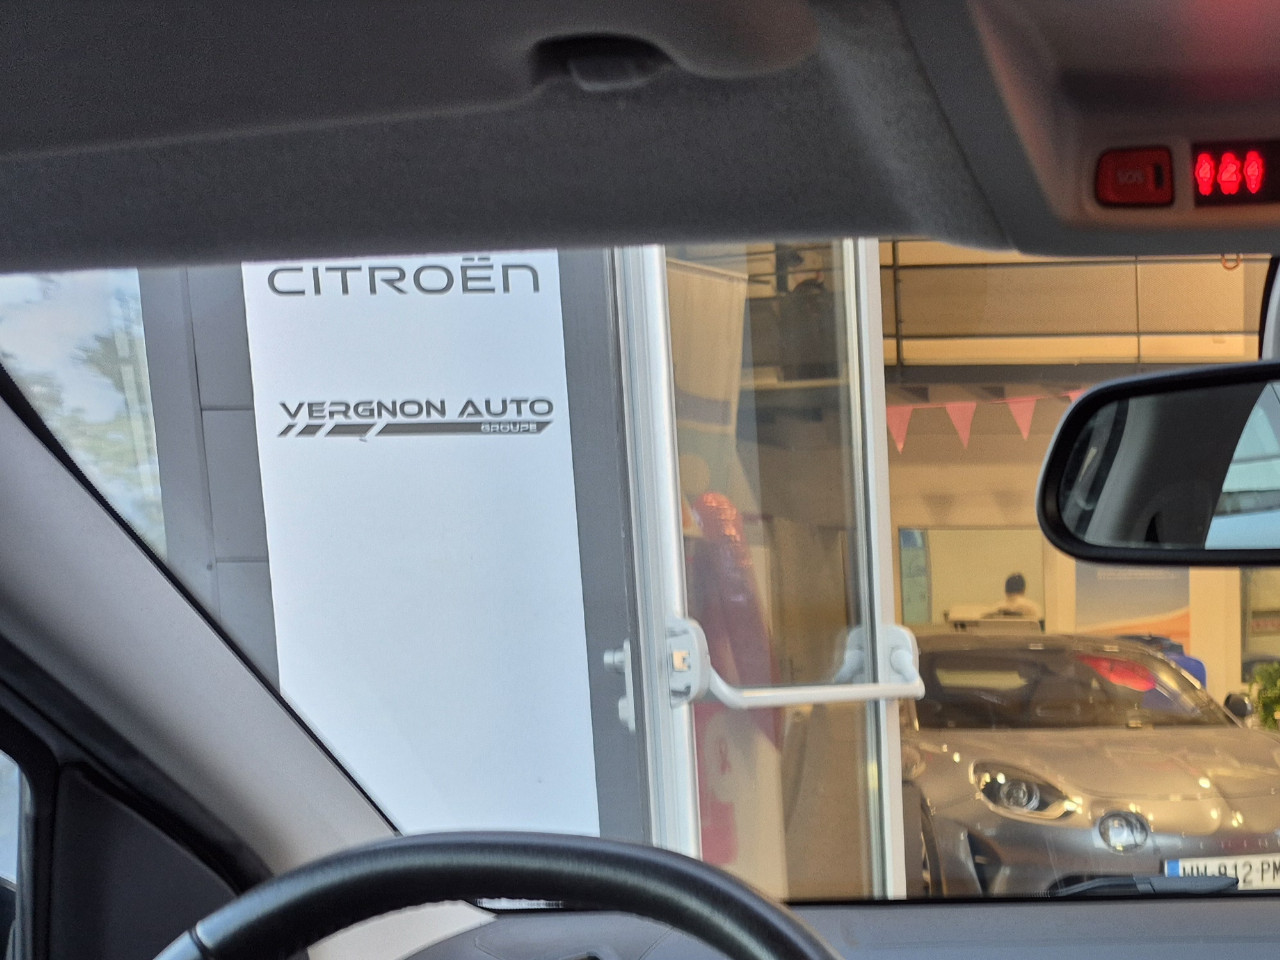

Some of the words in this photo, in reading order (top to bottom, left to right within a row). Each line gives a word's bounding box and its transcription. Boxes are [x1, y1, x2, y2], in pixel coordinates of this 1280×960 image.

[267, 256, 540, 296] CITROËN
[279, 399, 447, 420] VERGNON
[457, 397, 554, 419] AUTO
[481, 422, 537, 433] GROUPE
